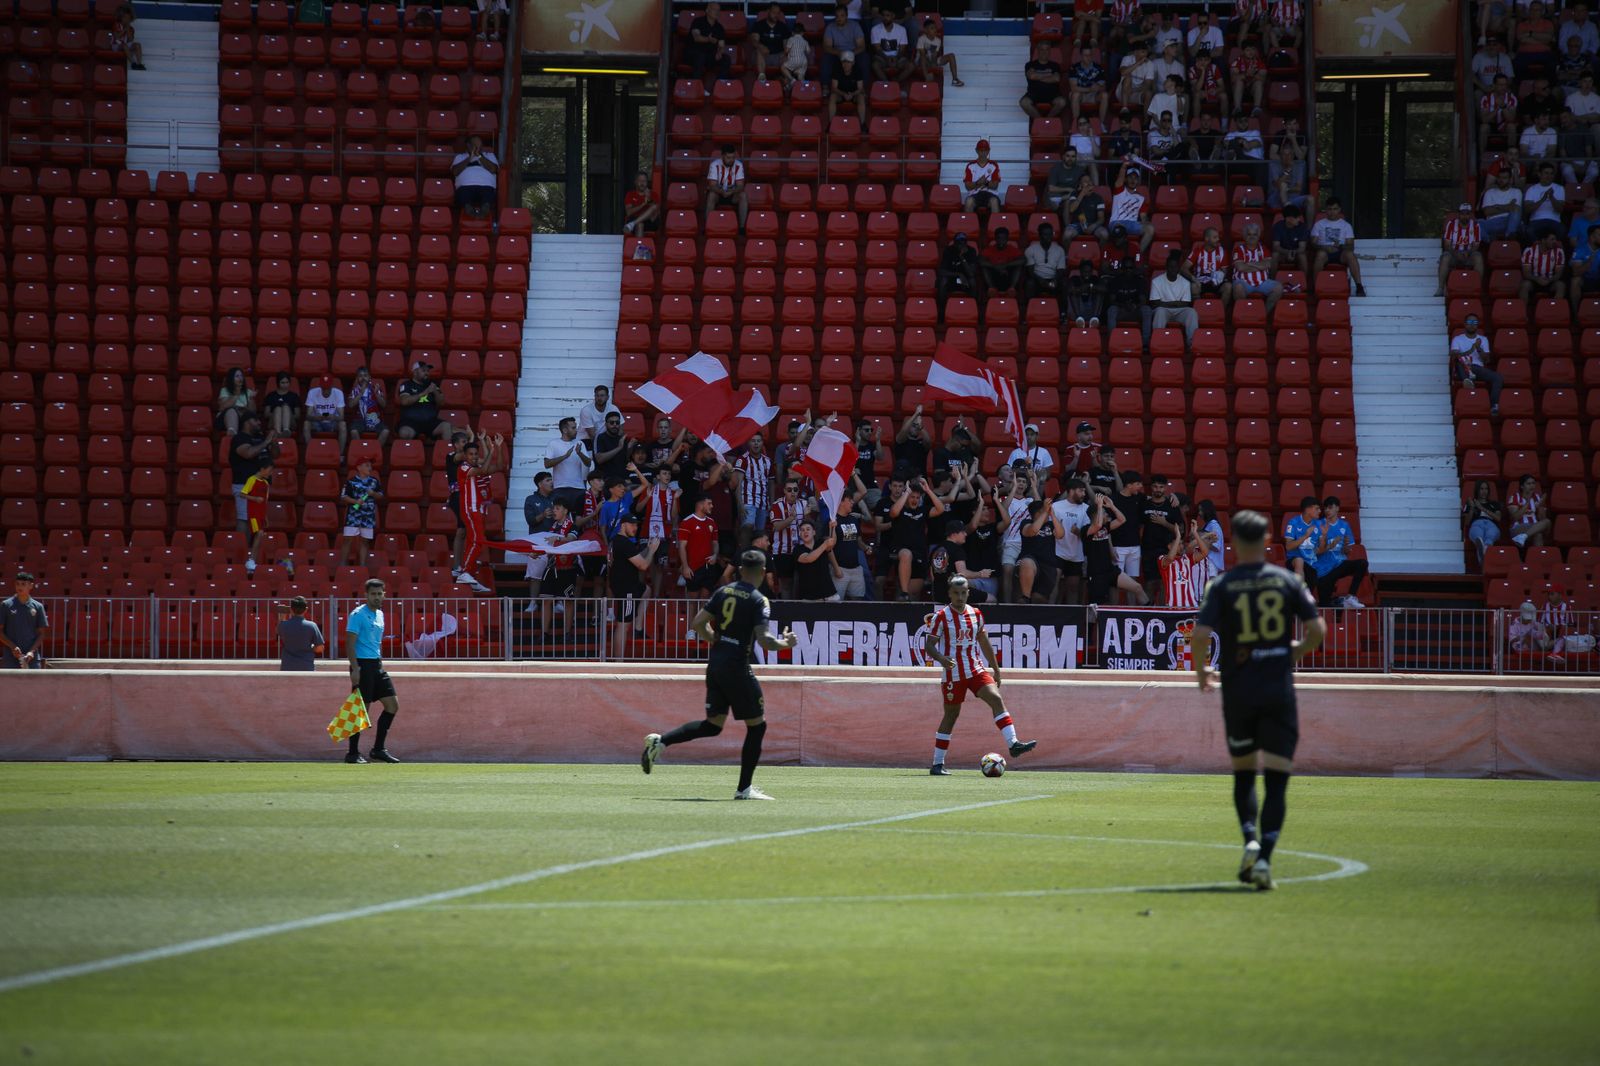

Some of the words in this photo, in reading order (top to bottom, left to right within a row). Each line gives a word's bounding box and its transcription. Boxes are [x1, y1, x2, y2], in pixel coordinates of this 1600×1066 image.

[719, 596, 737, 631] 9
[1234, 590, 1286, 643] 18
[1102, 617, 1167, 656] APC
[1107, 657, 1156, 671] SIEMPRE
